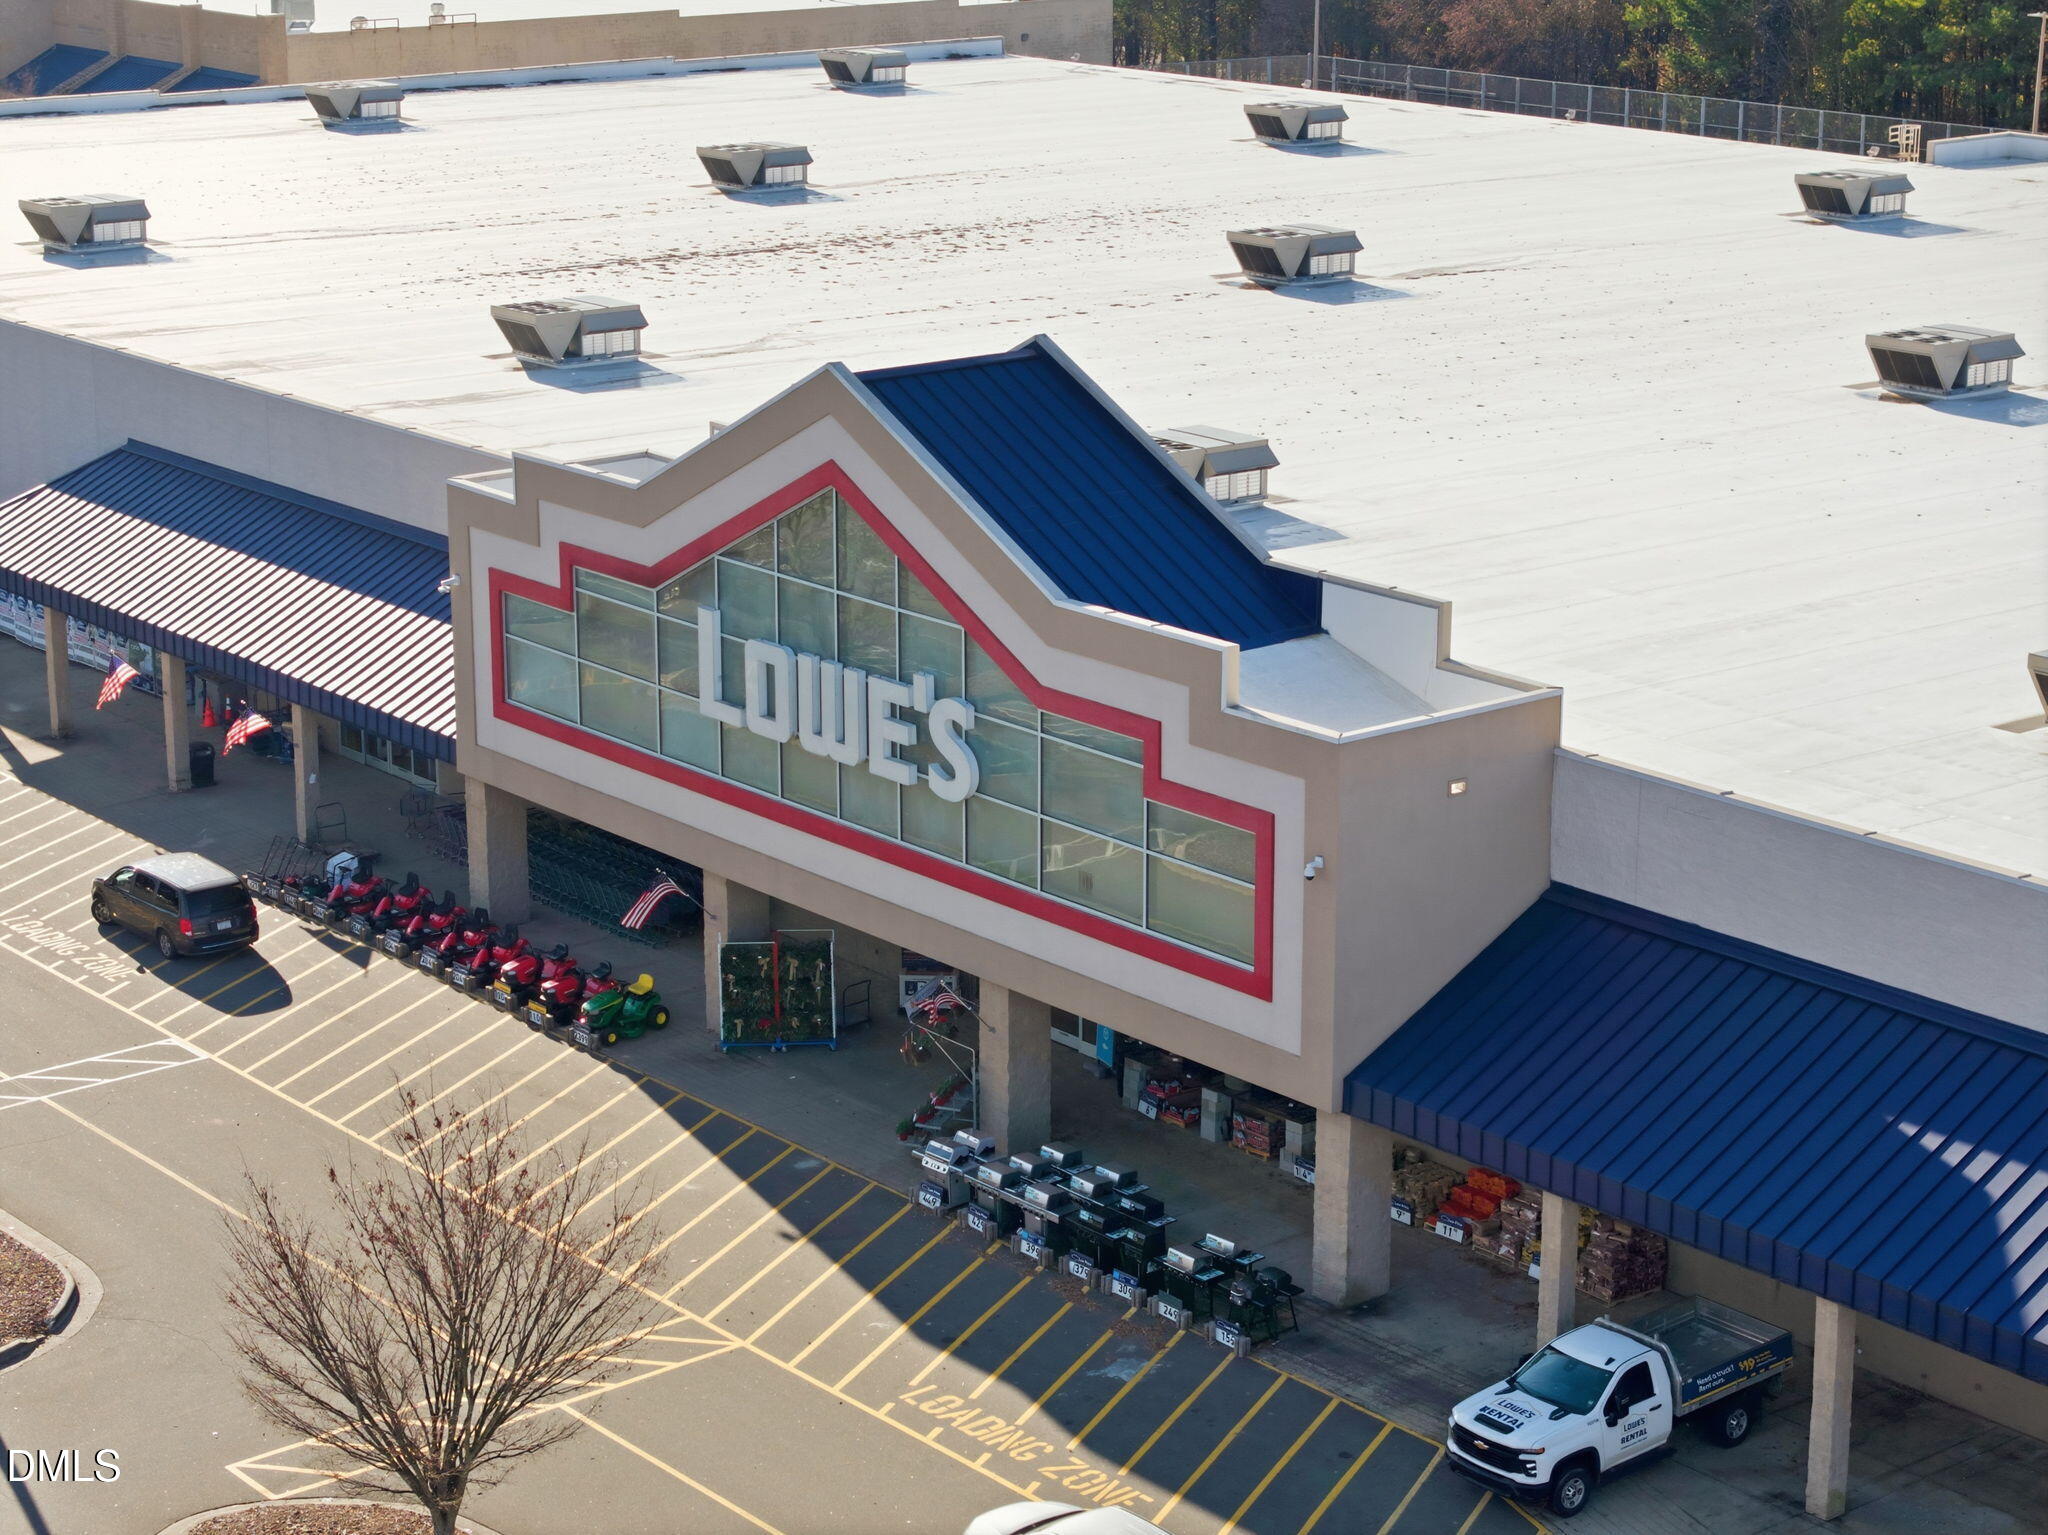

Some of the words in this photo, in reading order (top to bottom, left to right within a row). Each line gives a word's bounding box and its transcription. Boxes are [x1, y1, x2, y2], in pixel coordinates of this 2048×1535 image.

[698, 606, 980, 803] LOWE'S
[0, 914, 91, 956] LOADING
[70, 952, 140, 982] ZONE
[1696, 1374, 1712, 1386] Need
[1479, 1405, 1525, 1429] RENTAL
[1497, 1399, 1536, 1419] LOWE'S
[899, 1384, 1054, 1462] LOADING
[1623, 1417, 1646, 1432] LOWE'S
[1620, 1427, 1648, 1445] RENTAL
